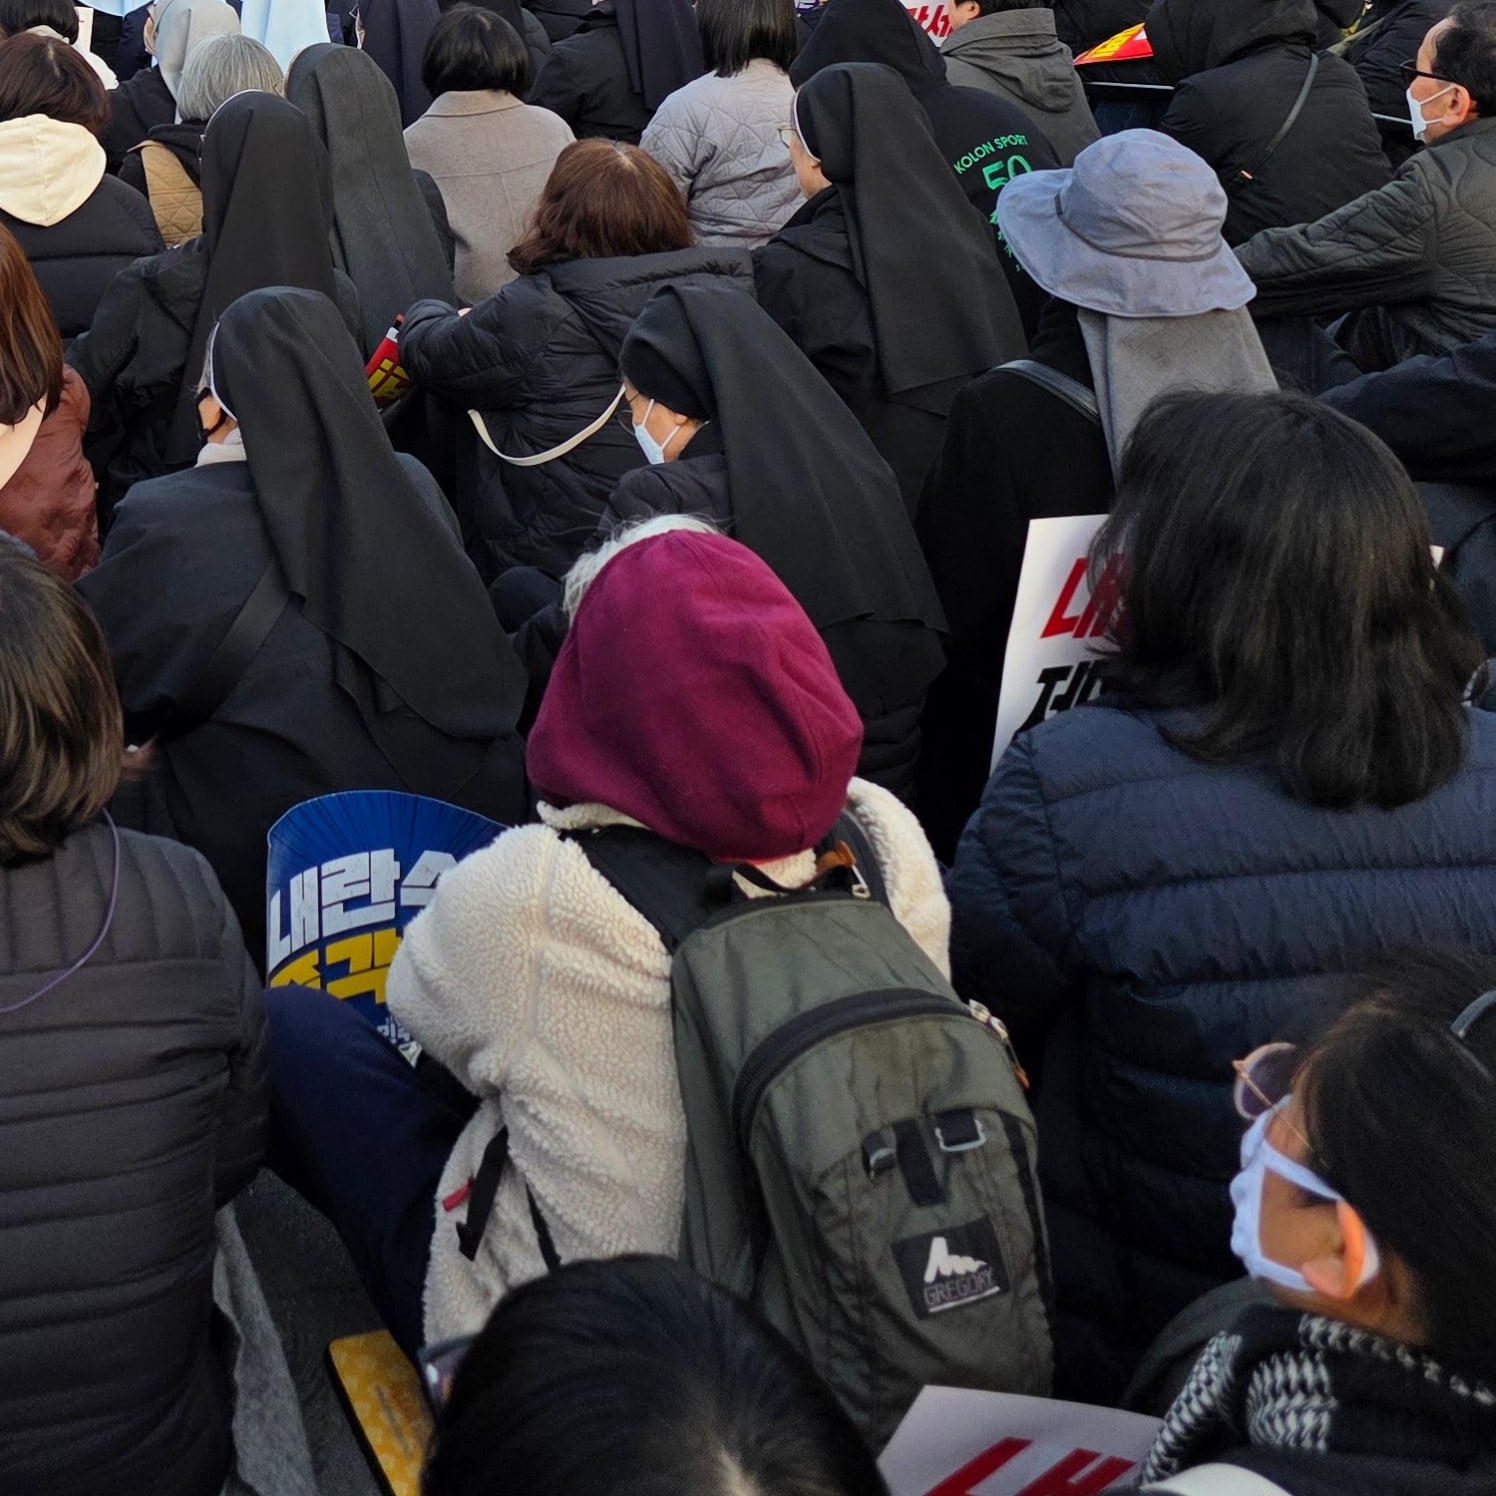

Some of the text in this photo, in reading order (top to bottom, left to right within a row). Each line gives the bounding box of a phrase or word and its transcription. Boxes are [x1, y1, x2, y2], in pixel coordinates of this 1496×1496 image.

[954, 134, 1028, 174] KOLON SPORT
[923, 1266, 994, 1306] GREGORY
